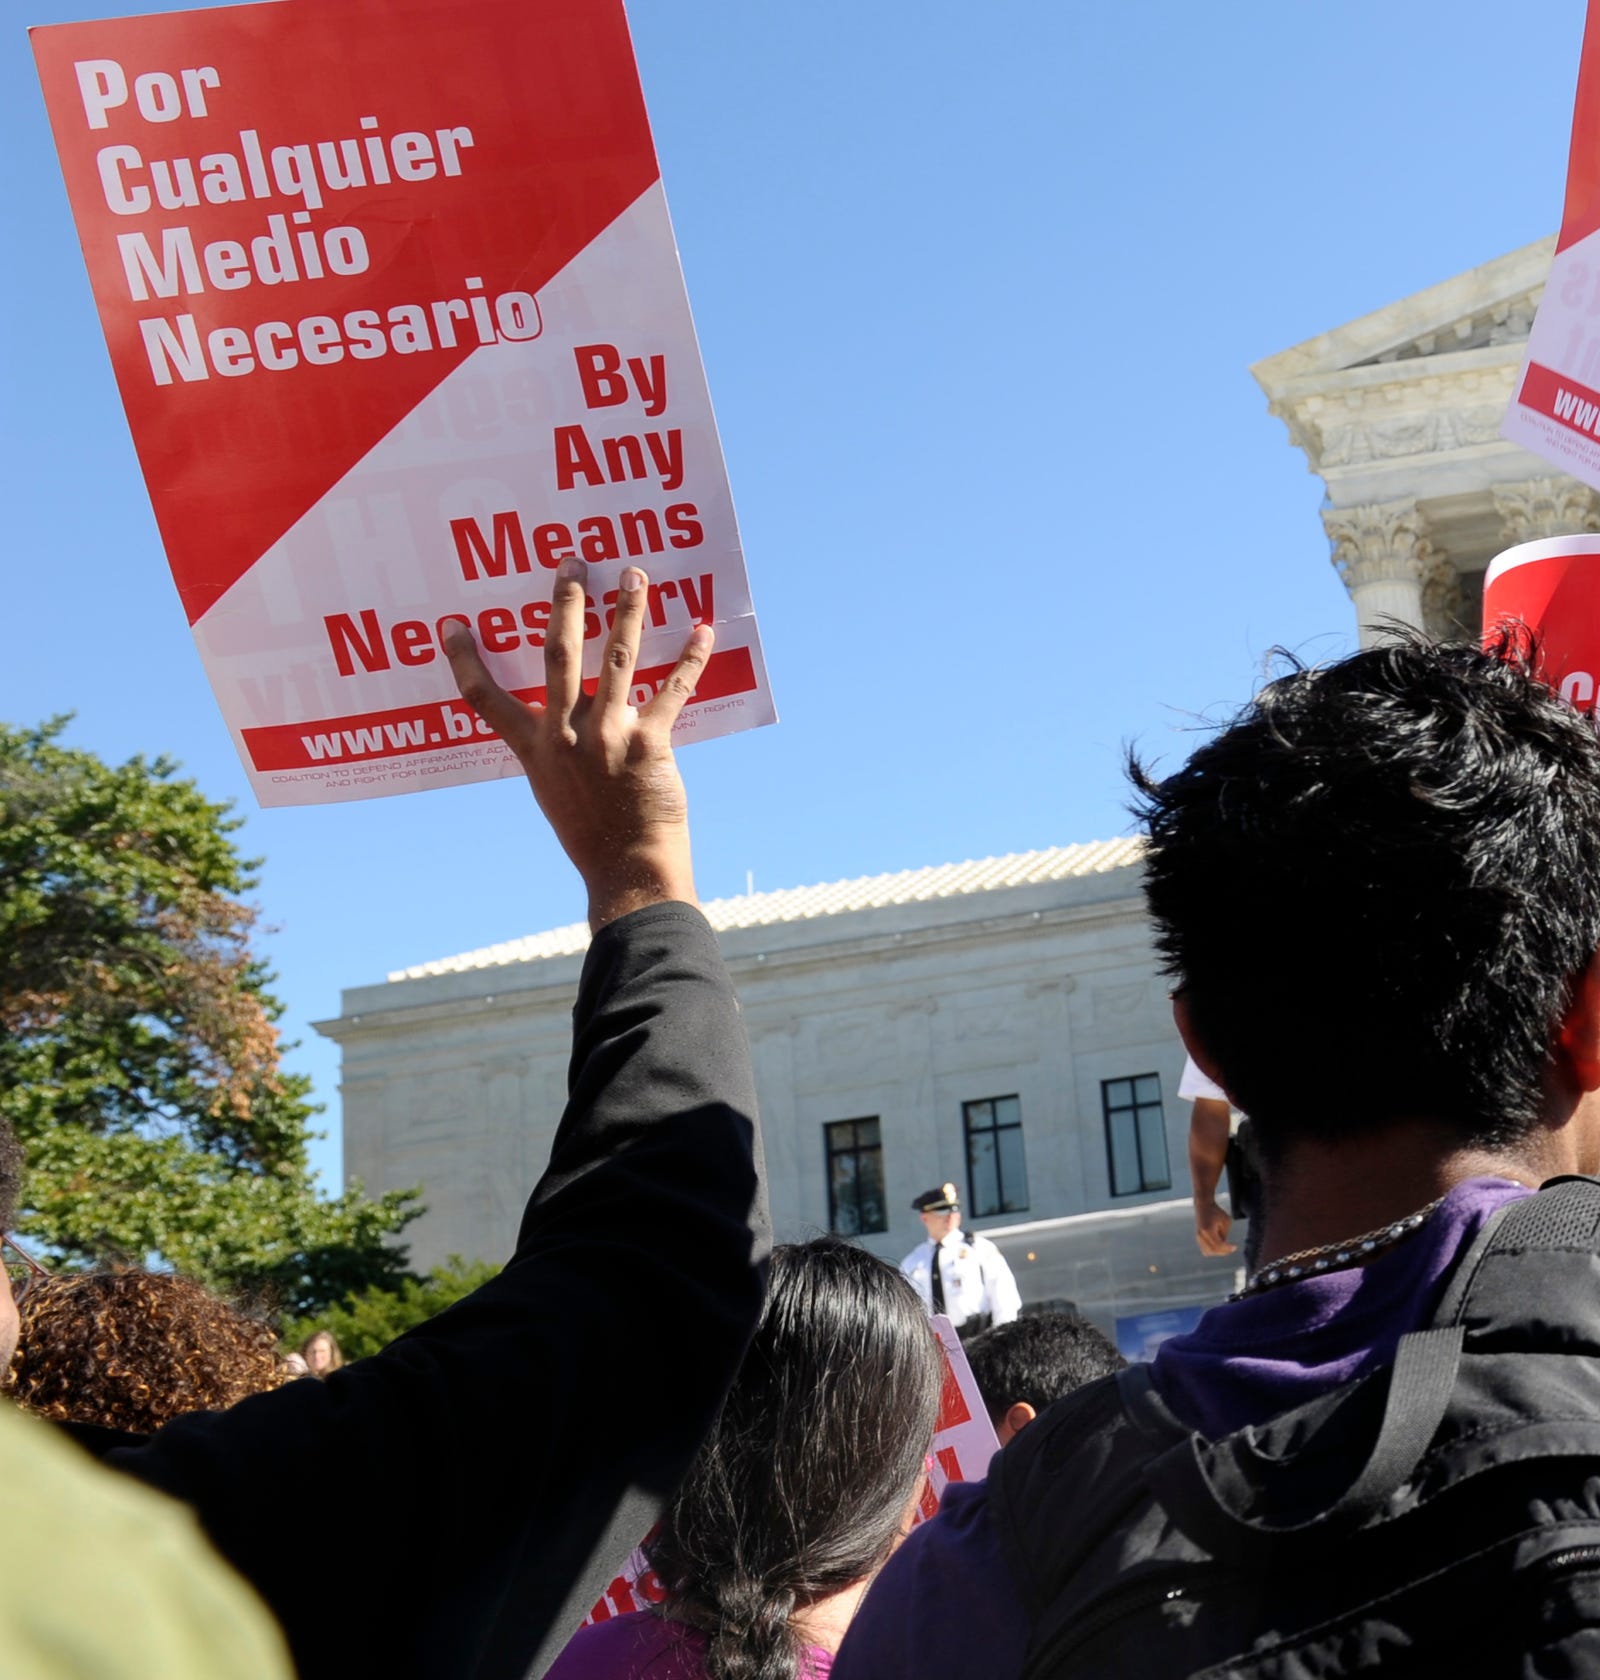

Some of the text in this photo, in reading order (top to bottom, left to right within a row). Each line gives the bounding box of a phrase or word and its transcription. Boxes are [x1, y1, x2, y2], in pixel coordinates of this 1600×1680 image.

[74, 59, 221, 131] Por
[96, 116, 475, 217] Cualquier
[117, 210, 370, 302] Medio
[138, 277, 543, 386] Necesario
[573, 343, 667, 416] By
[553, 425, 683, 491] Any
[450, 502, 704, 582] Means
